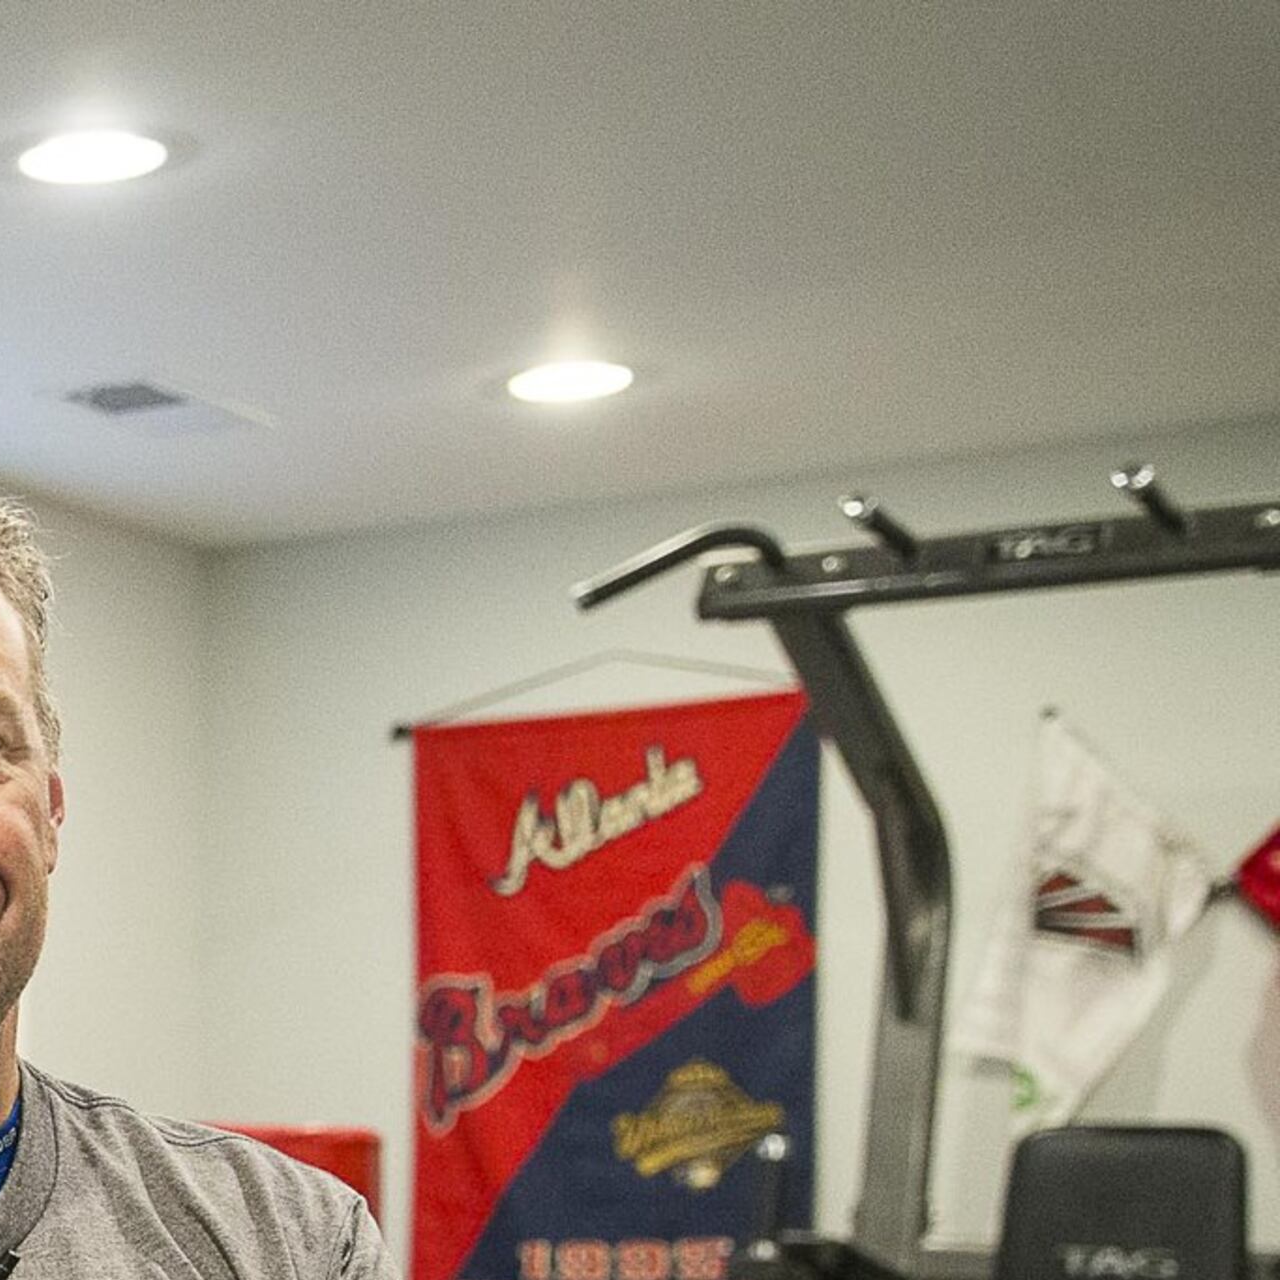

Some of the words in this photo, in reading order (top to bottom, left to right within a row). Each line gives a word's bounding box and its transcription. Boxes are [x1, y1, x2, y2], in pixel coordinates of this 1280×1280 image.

[488, 745, 703, 896] Atlanta
[418, 864, 723, 1137] Braves
[1060, 1245, 1180, 1280] TAG
